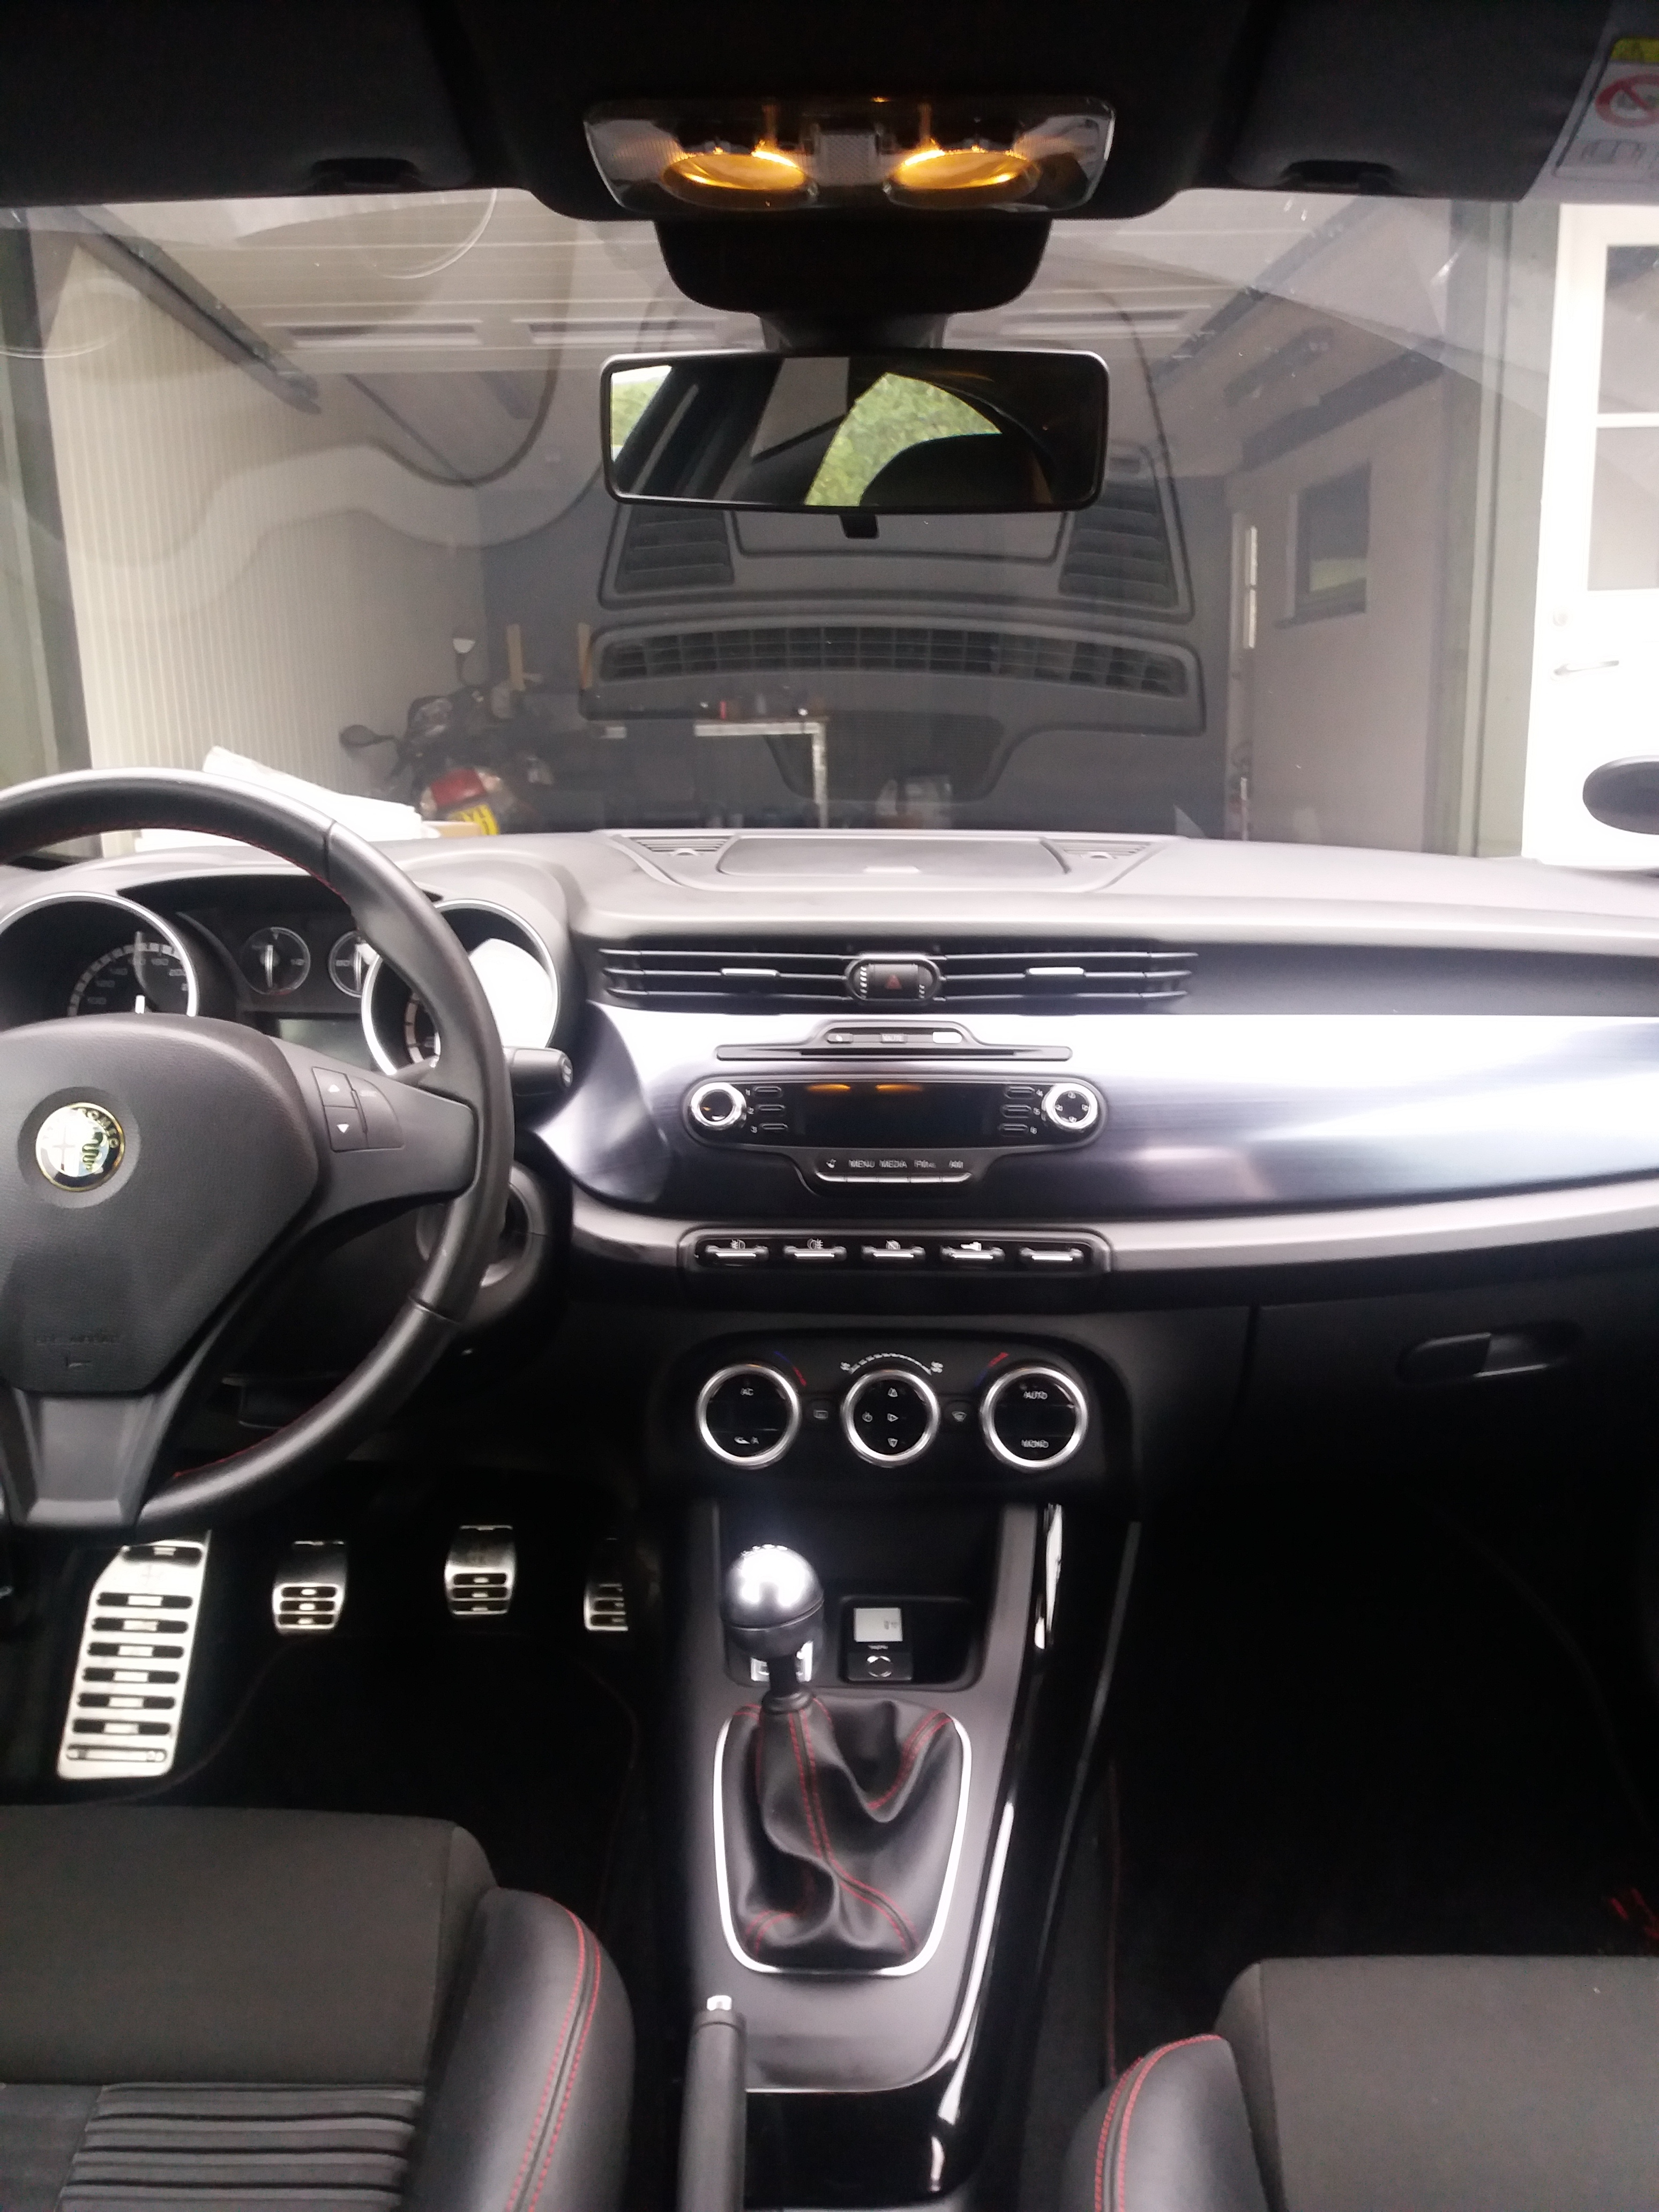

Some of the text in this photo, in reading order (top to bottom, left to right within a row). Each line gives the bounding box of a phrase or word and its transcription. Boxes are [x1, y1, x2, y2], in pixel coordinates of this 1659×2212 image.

[849, 1159, 875, 1168] MENU
[879, 1159, 908, 1168] MEDIA
[1023, 1391, 1048, 1400] AUTO
[1021, 1439, 1049, 1448] MONO
